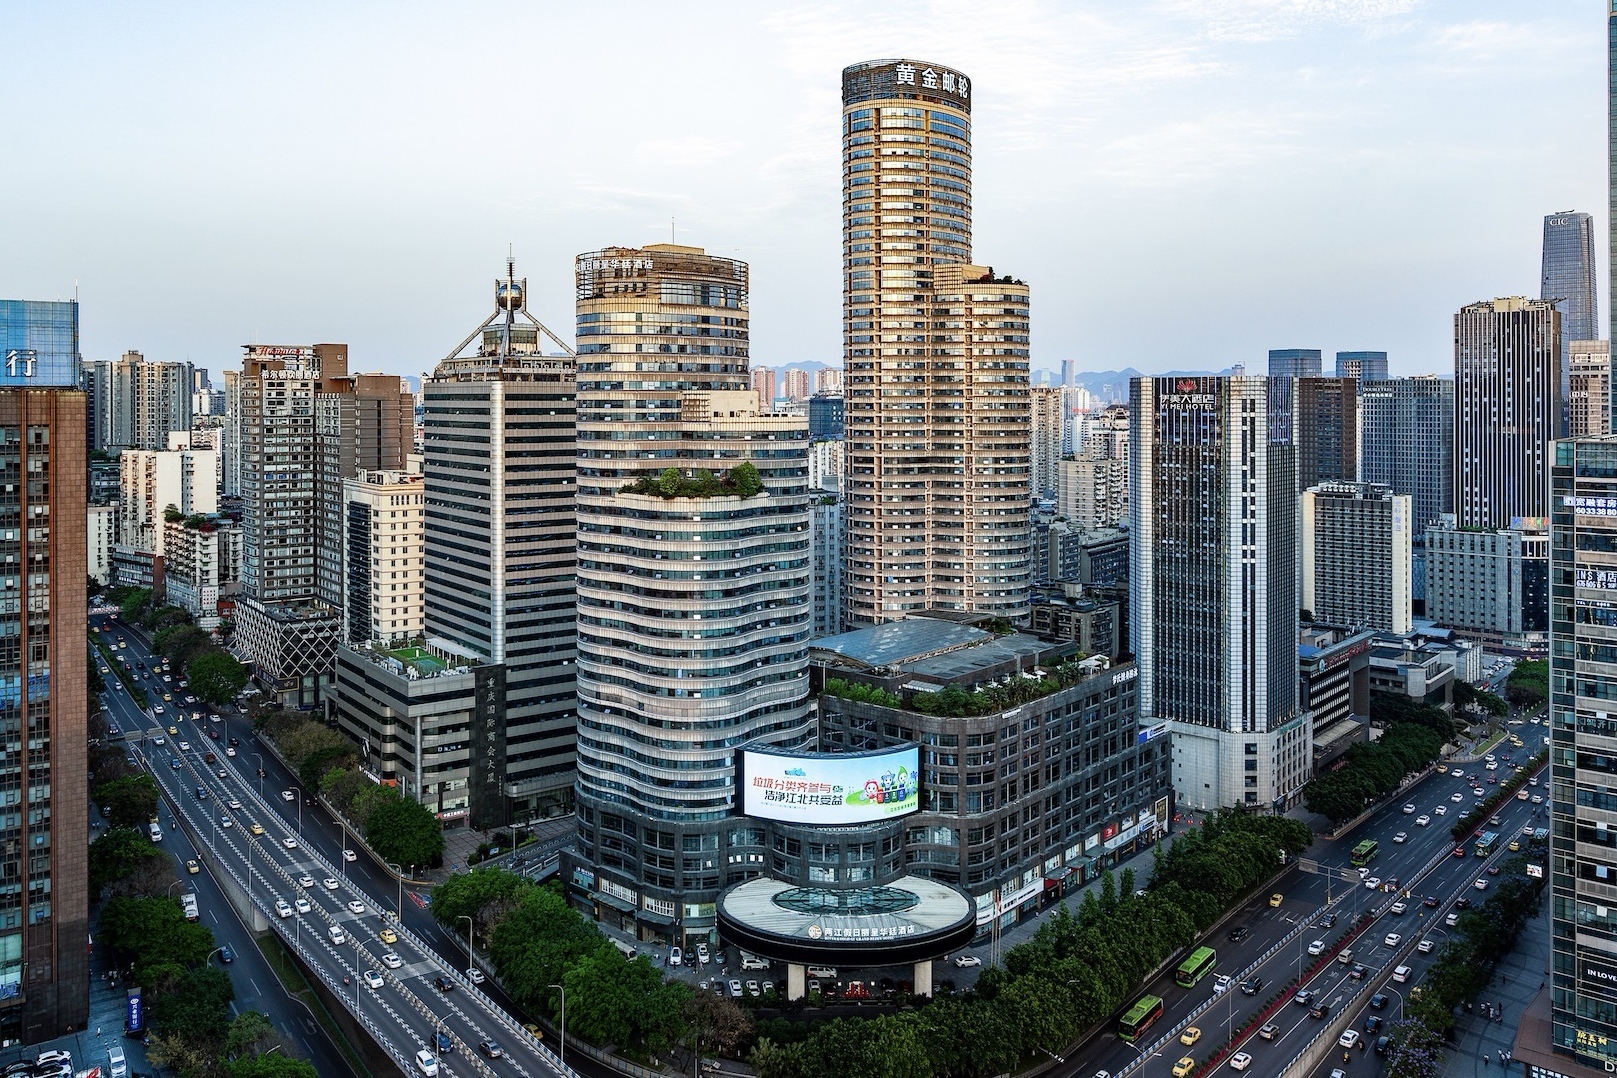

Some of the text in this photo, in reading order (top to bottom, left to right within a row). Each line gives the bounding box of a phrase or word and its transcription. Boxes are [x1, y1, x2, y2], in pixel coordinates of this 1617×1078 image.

[896, 63, 968, 98] 黄金邮轮
[1550, 218, 1568, 226] CIC
[6, 350, 37, 377] 行
[753, 776, 832, 793] 垃圾分类齐参与
[764, 789, 843, 806] 洁净江北共受益
[1604, 1060, 1617, 1073] D
